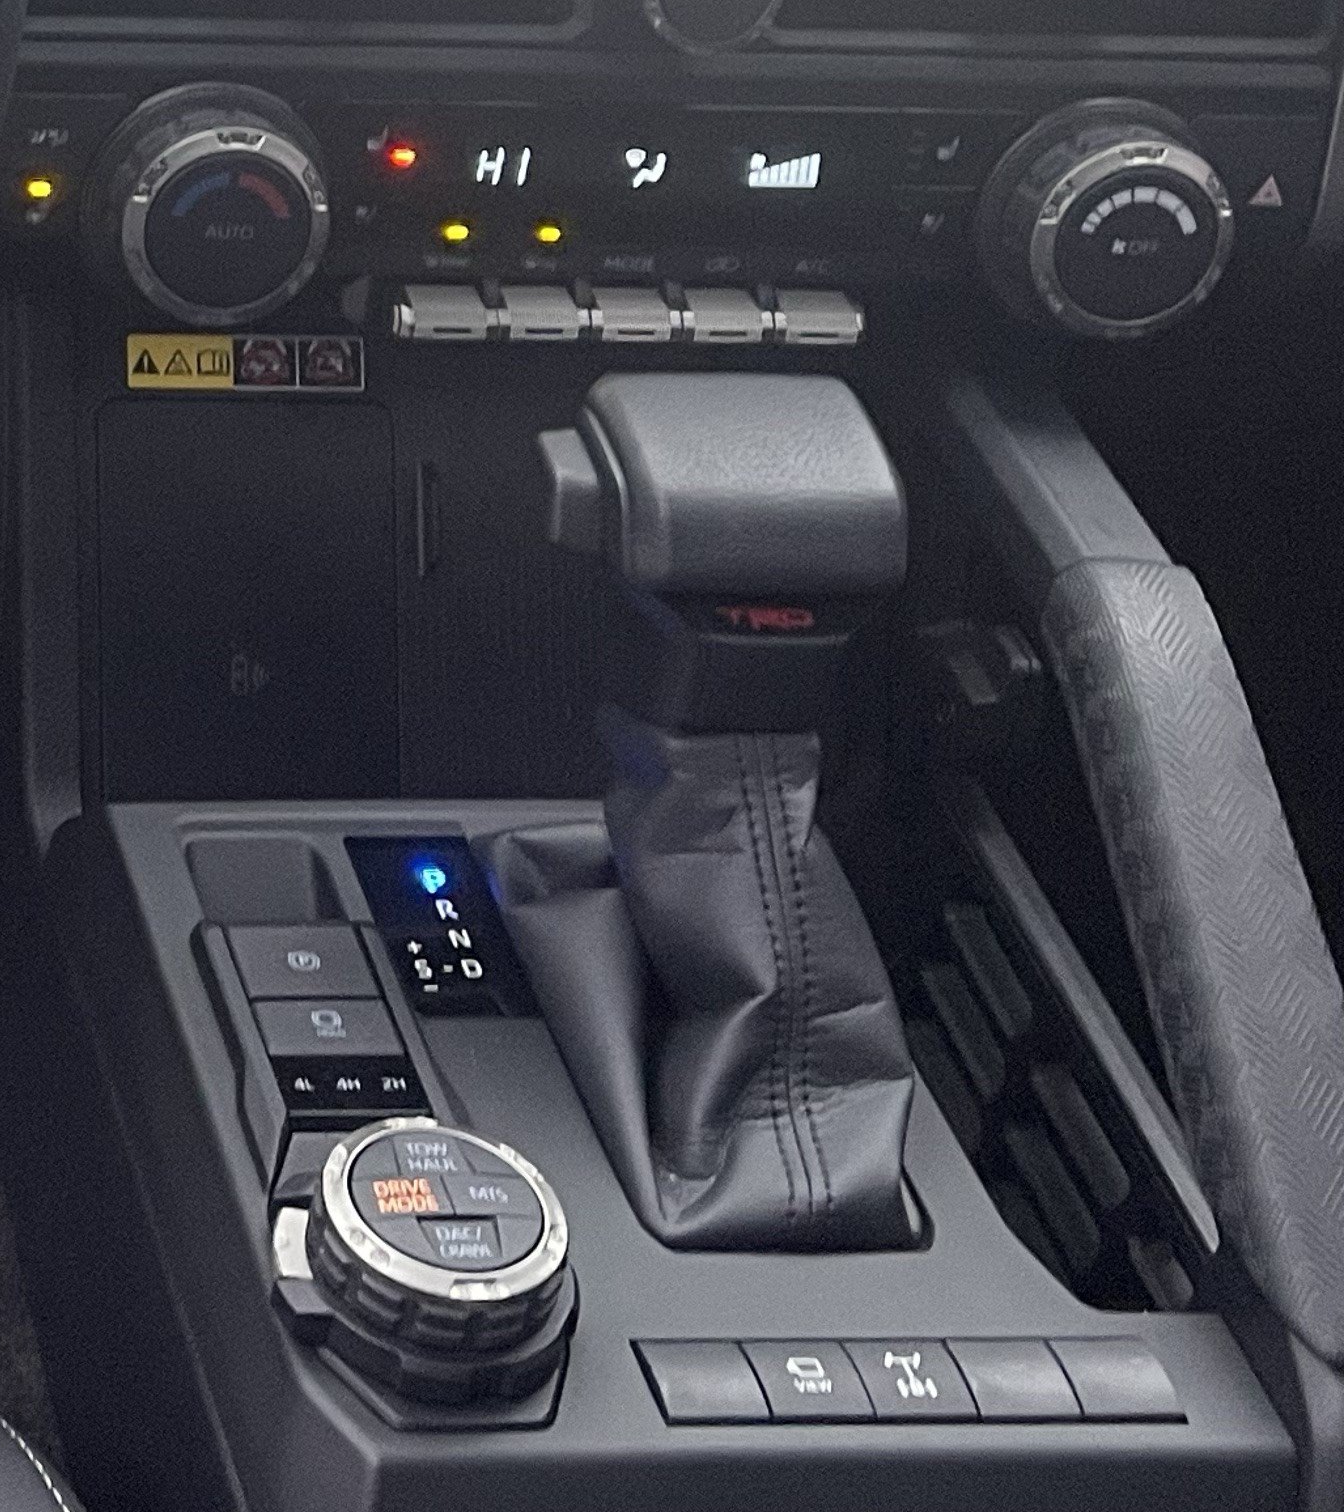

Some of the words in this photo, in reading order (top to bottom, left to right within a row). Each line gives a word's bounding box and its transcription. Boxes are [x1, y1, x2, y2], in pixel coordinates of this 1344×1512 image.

[205, 223, 255, 239] AUTO
[423, 867, 446, 894] P
[435, 898, 459, 921] R
[448, 928, 472, 949] N
[414, 959, 433, 980] S
[461, 958, 483, 979] D
[373, 1178, 433, 1198] DRIVE
[378, 1194, 440, 1214] MODE
